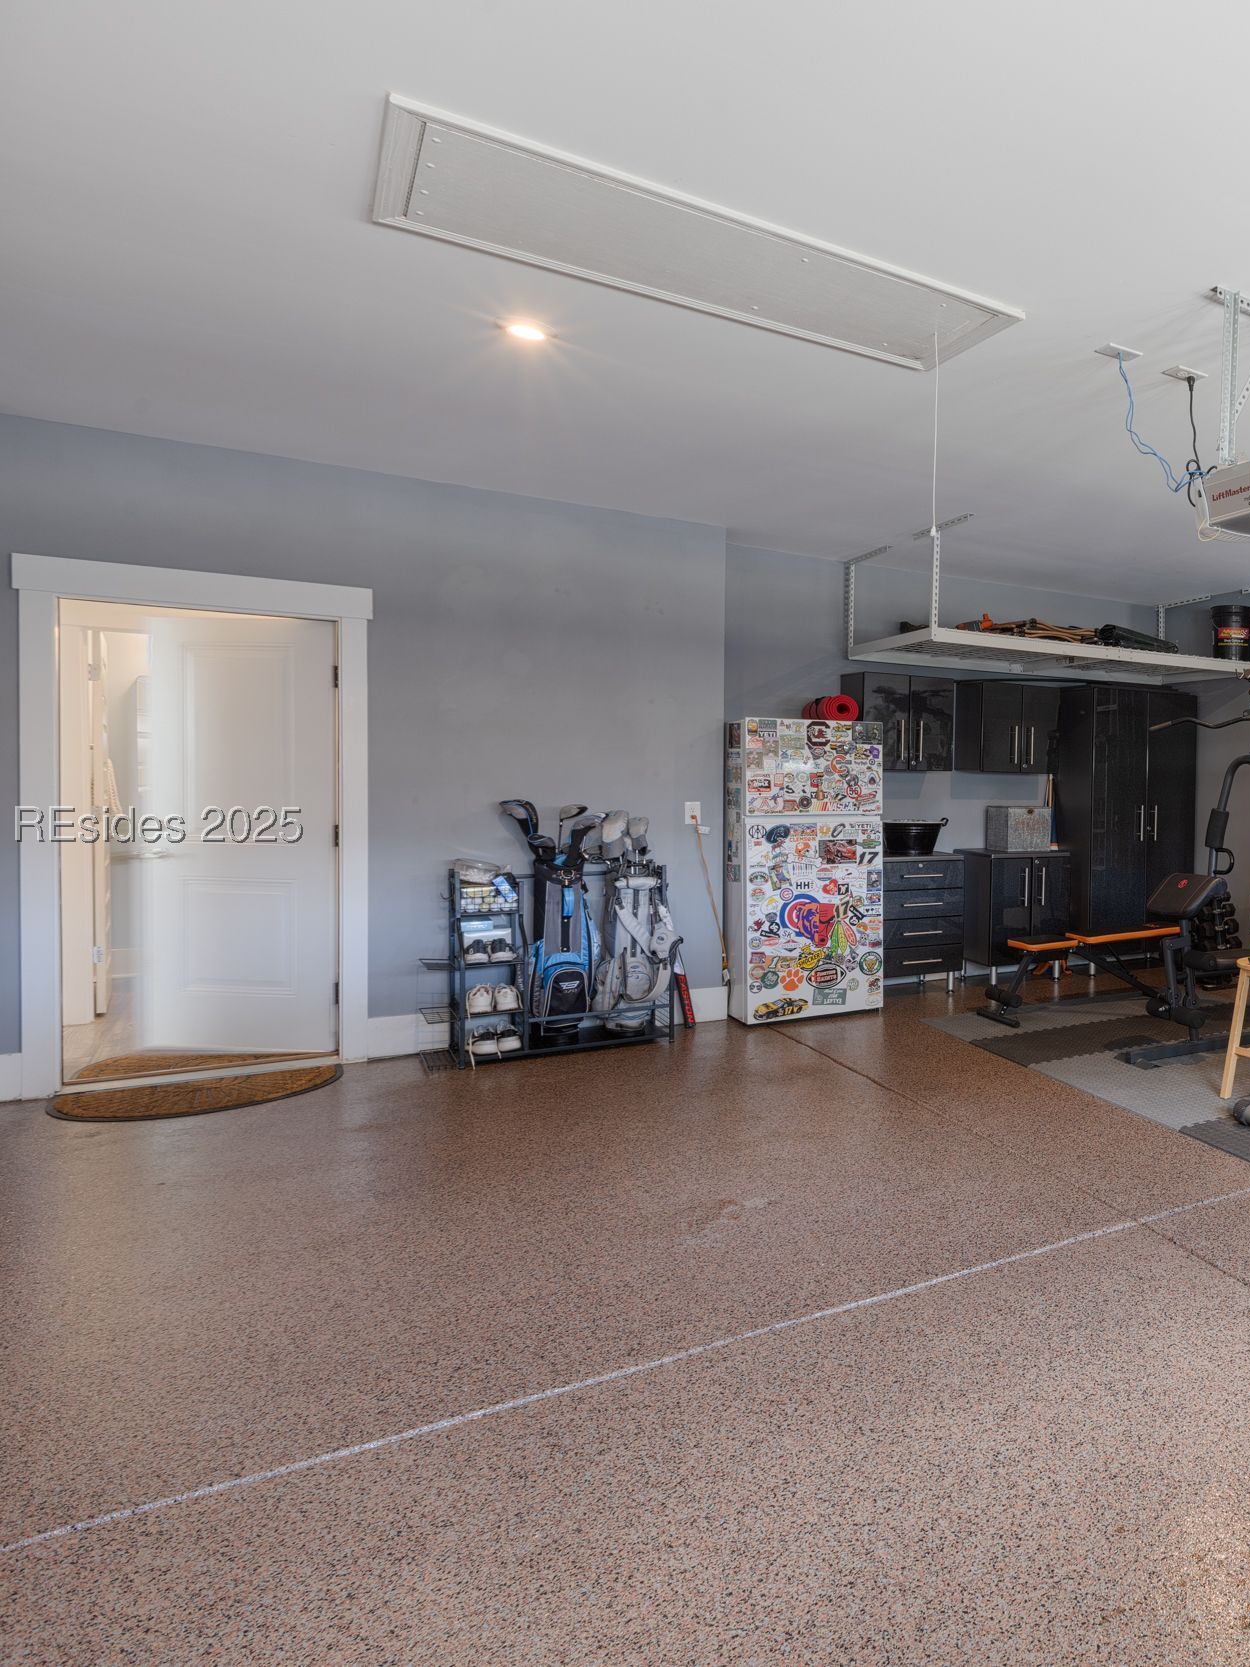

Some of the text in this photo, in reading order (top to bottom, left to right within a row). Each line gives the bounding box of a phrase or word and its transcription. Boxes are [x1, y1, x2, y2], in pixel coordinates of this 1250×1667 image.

[1211, 485, 1250, 502] LiftMaster
[858, 851, 880, 866] 17
[677, 975, 694, 1023] EASTON
